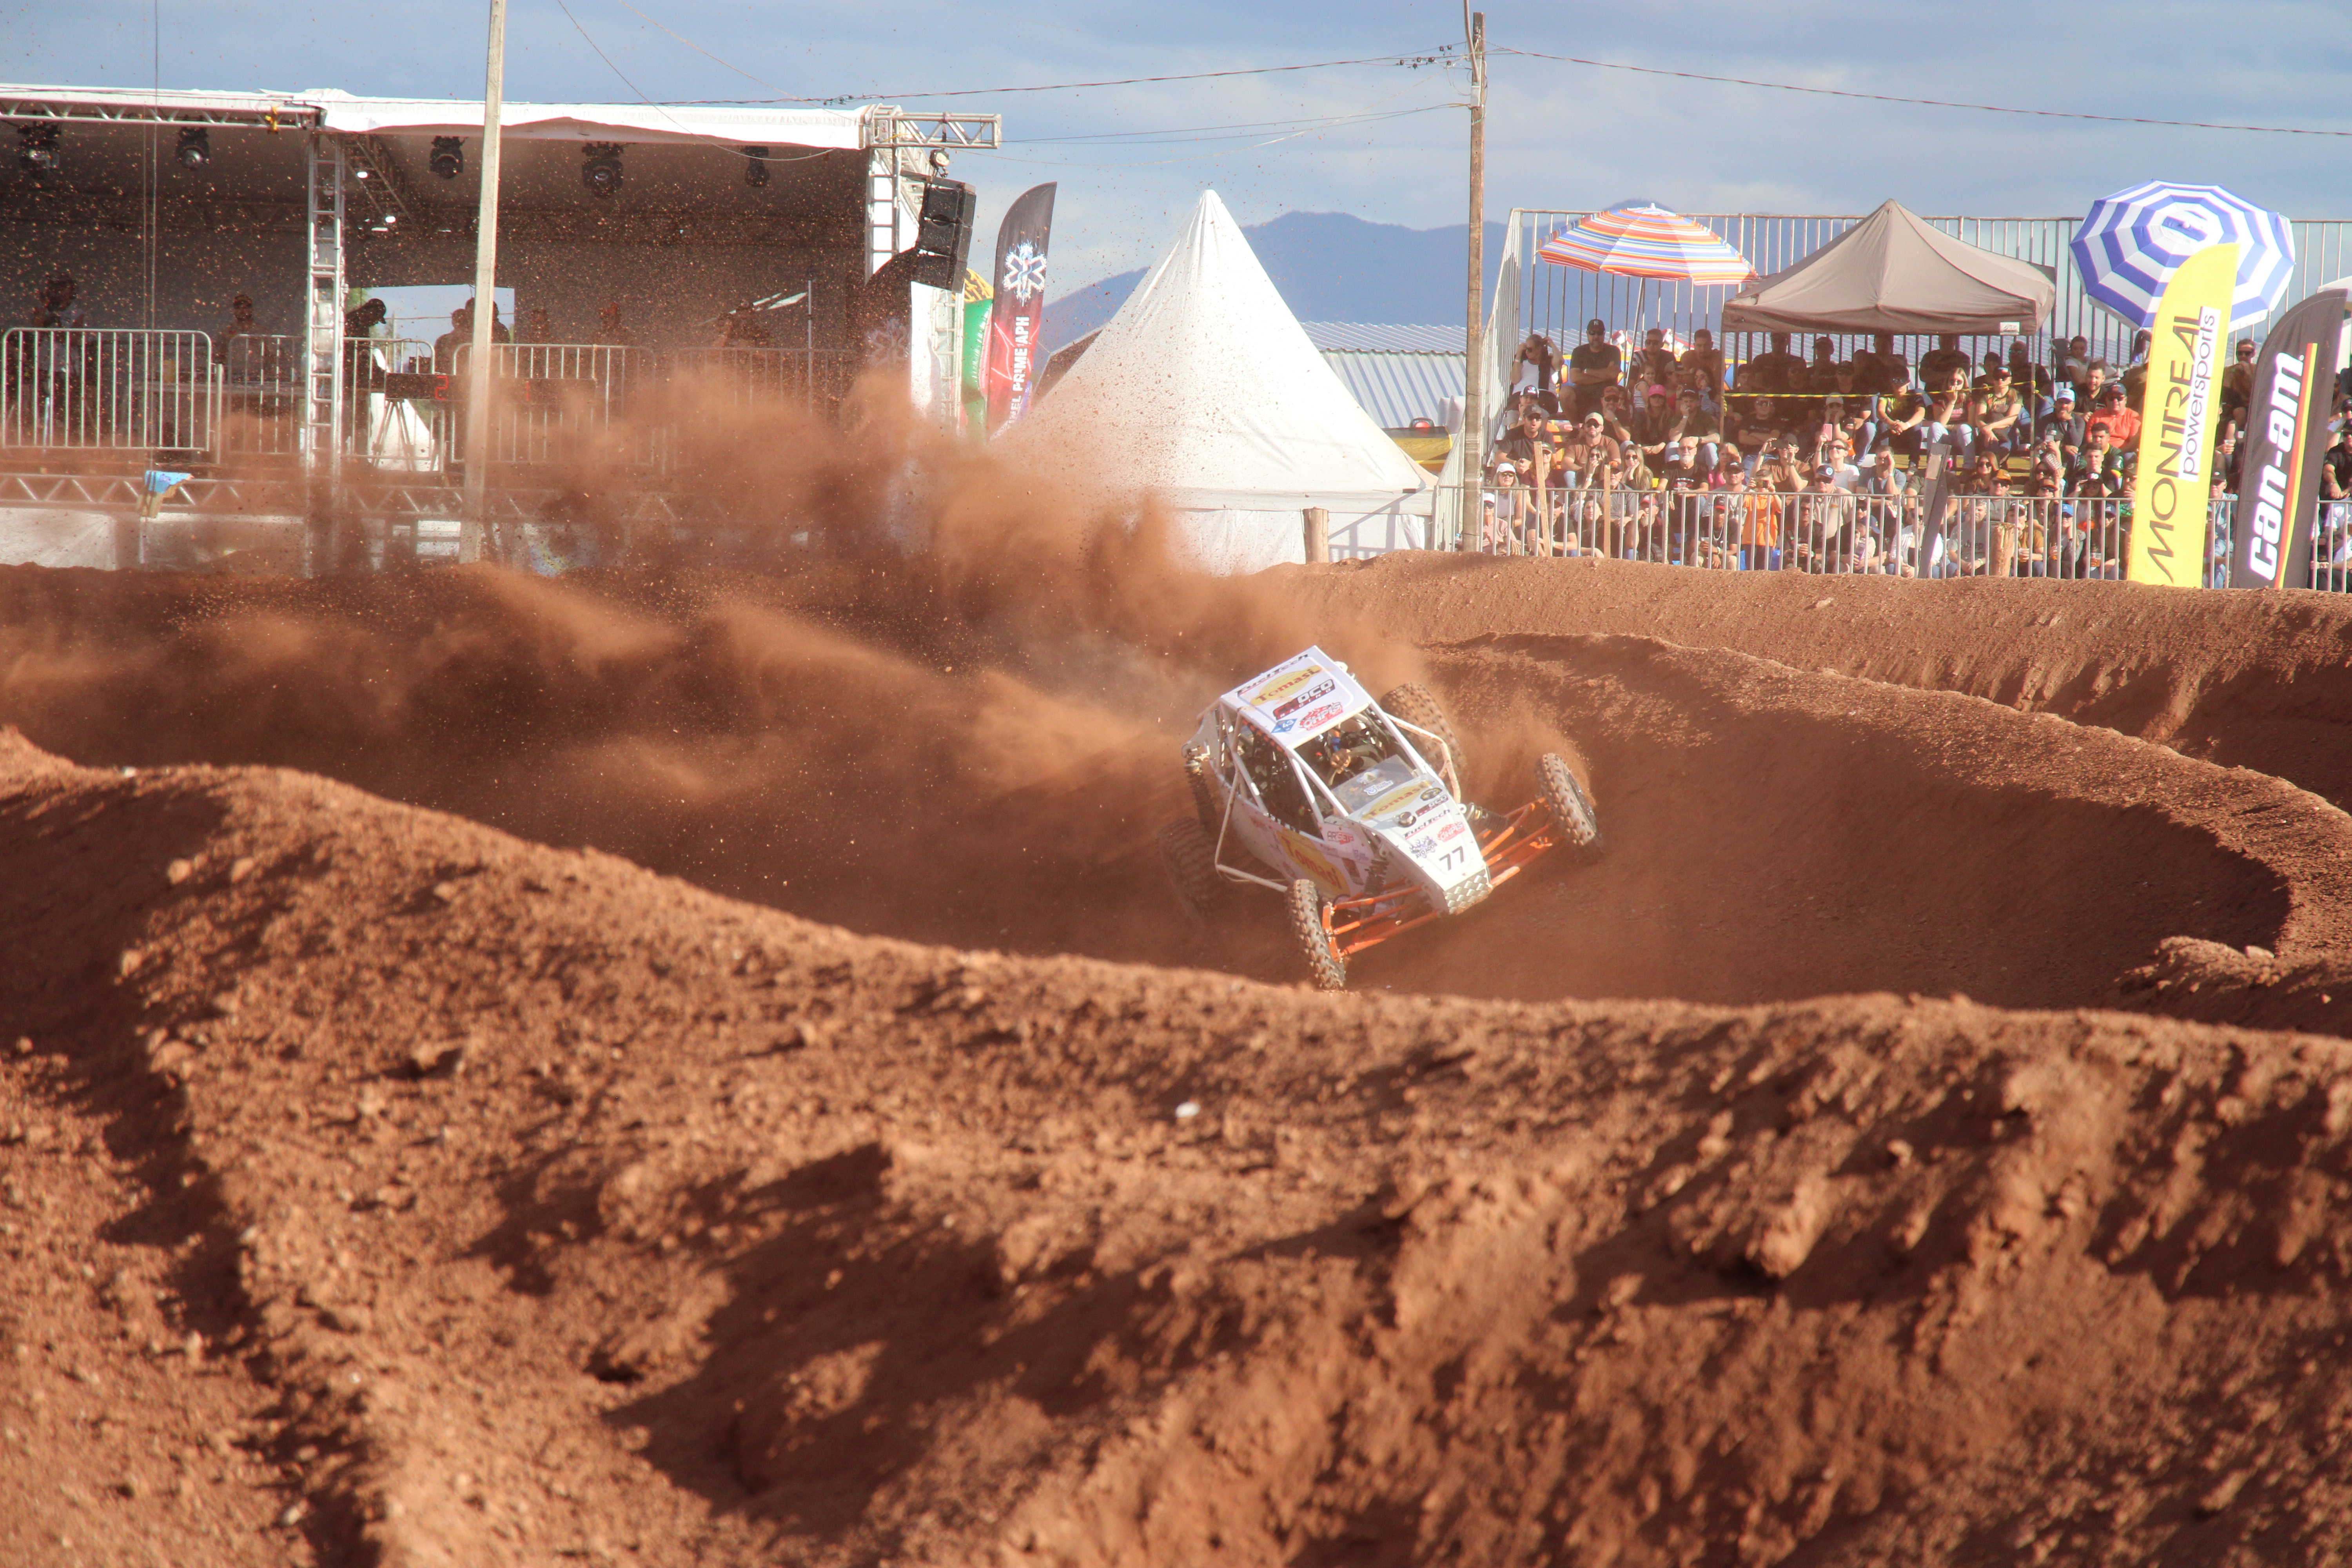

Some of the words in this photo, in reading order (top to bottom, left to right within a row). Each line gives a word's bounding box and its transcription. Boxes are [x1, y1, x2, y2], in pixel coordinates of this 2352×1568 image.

[1015, 316, 1030, 345] APH
[1013, 348, 1027, 391] PRIME
[435, 376, 449, 400] 2
[2183, 314, 2214, 476] powersports
[2147, 306, 2203, 584] MONTREAL
[2250, 352, 2304, 581] can-am
[1256, 668, 1321, 702] Tomasi
[1282, 720, 1295, 728] 43
[1368, 781, 1433, 816] Tomasi
[1403, 809, 1450, 837] FuelTech
[1439, 846, 1464, 871] 77
